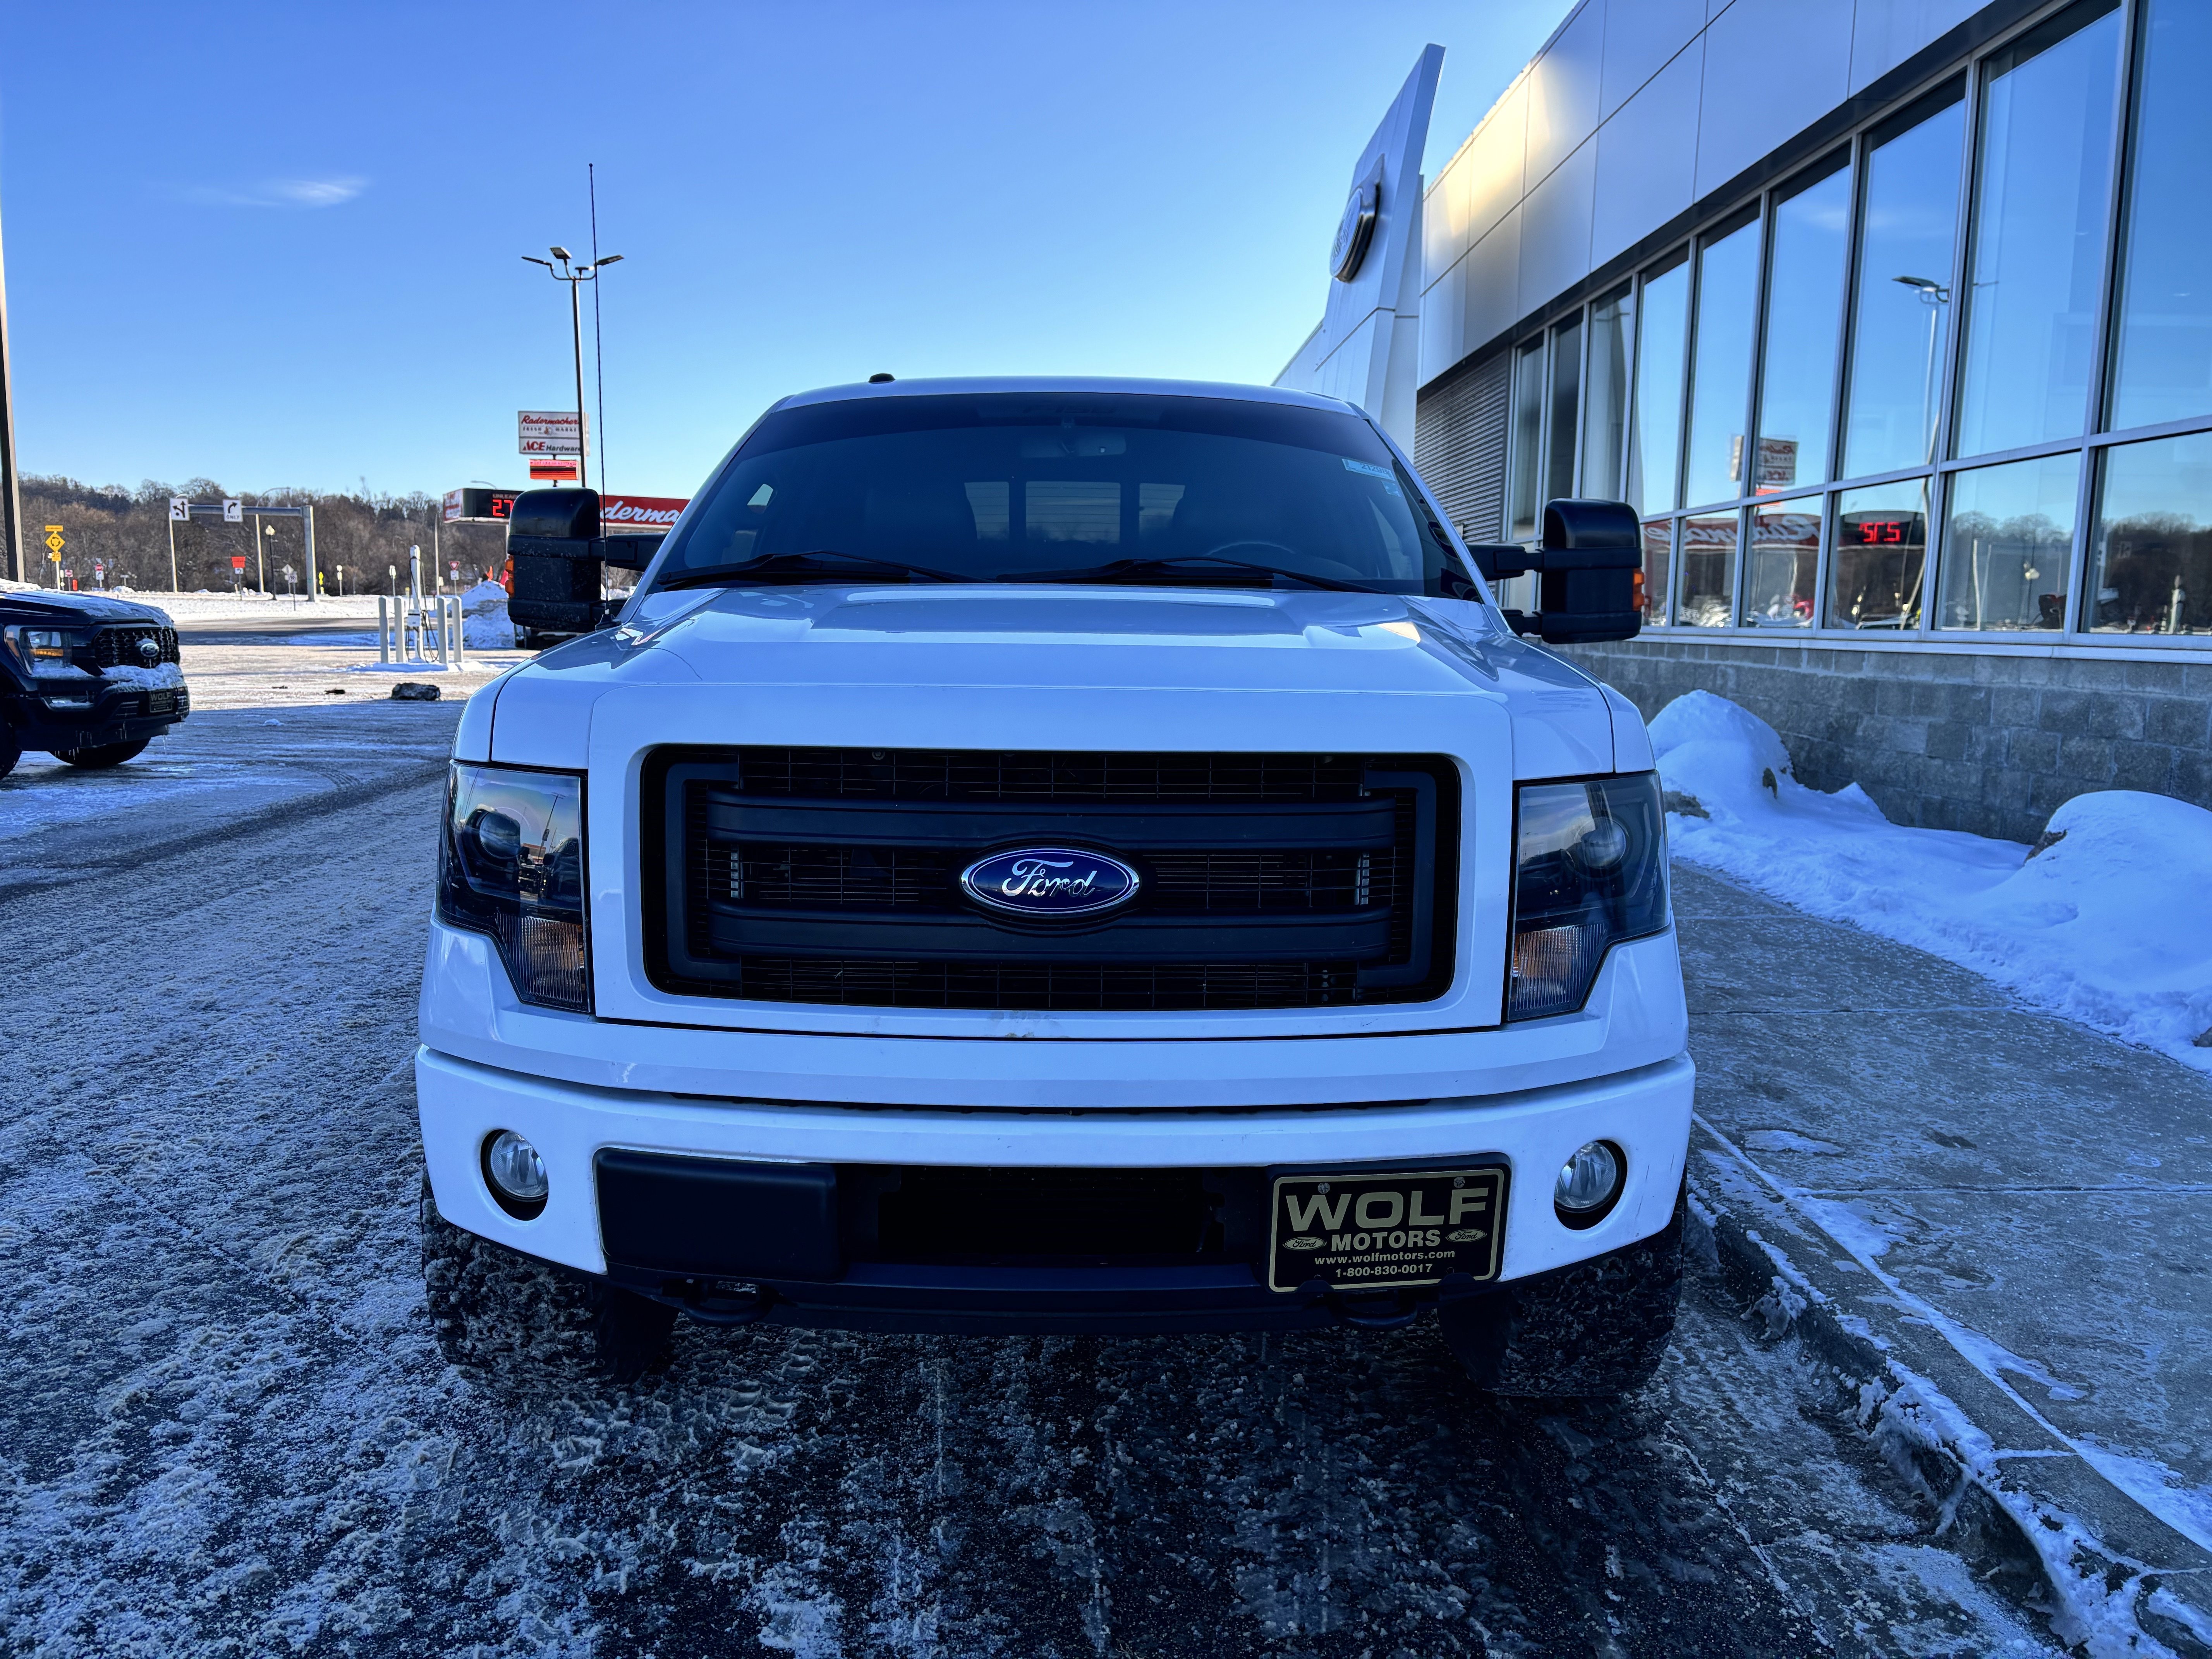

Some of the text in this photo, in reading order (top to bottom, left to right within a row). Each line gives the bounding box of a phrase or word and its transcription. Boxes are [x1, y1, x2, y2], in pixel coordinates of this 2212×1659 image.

[521, 415, 579, 425] Radermacher
[523, 440, 546, 451] ACE
[492, 499, 514, 517] 27
[600, 500, 680, 523] derma
[150, 692, 172, 701] WOLF
[1002, 859, 1097, 897] Ford
[1286, 1187, 1489, 1231] WOLF
[1331, 1230, 1441, 1251] MOTORS
[1455, 1231, 1478, 1240] Ford
[1292, 1238, 1317, 1248] Ford
[1314, 1250, 1455, 1265] www.wolfmotors.com
[1336, 1264, 1433, 1278] 1-800-830-0017
